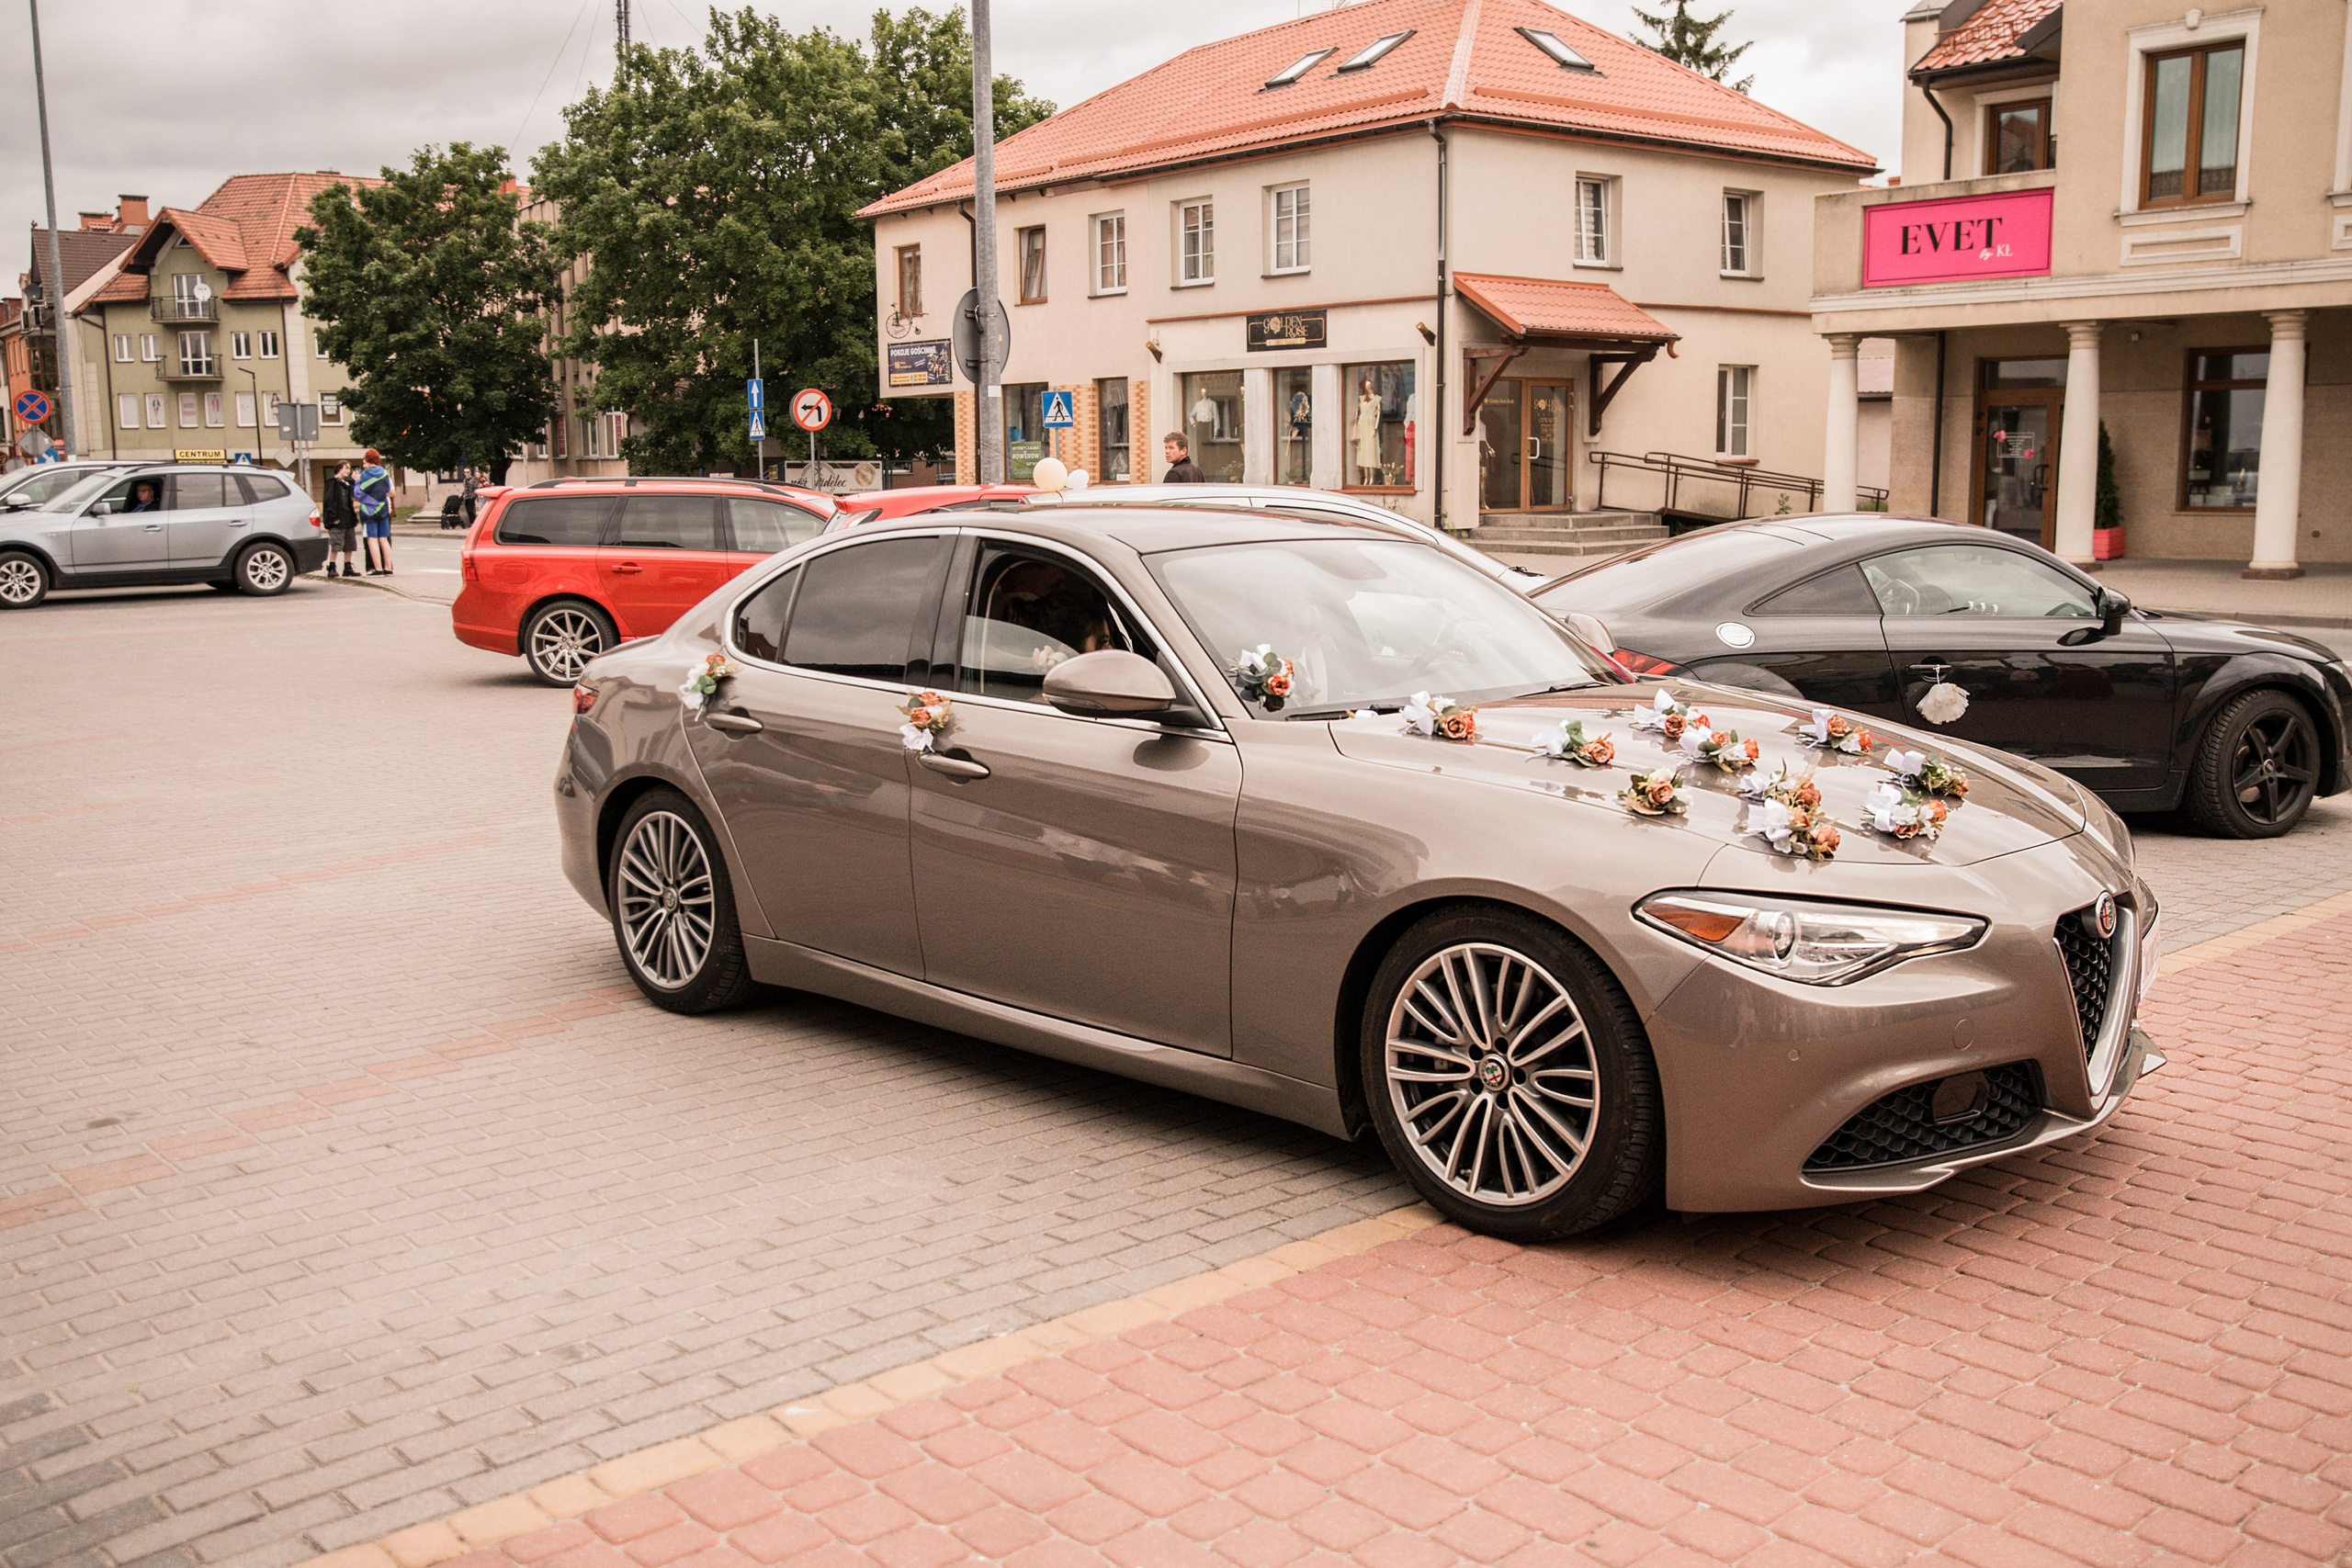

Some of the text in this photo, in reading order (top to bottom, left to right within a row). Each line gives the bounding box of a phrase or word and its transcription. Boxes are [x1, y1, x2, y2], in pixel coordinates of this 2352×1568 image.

[1900, 218, 2003, 255] EVET
[1979, 248, 1994, 261] by
[1285, 325, 1309, 338] ROSE
[910, 345, 936, 355] GOŚCINNE
